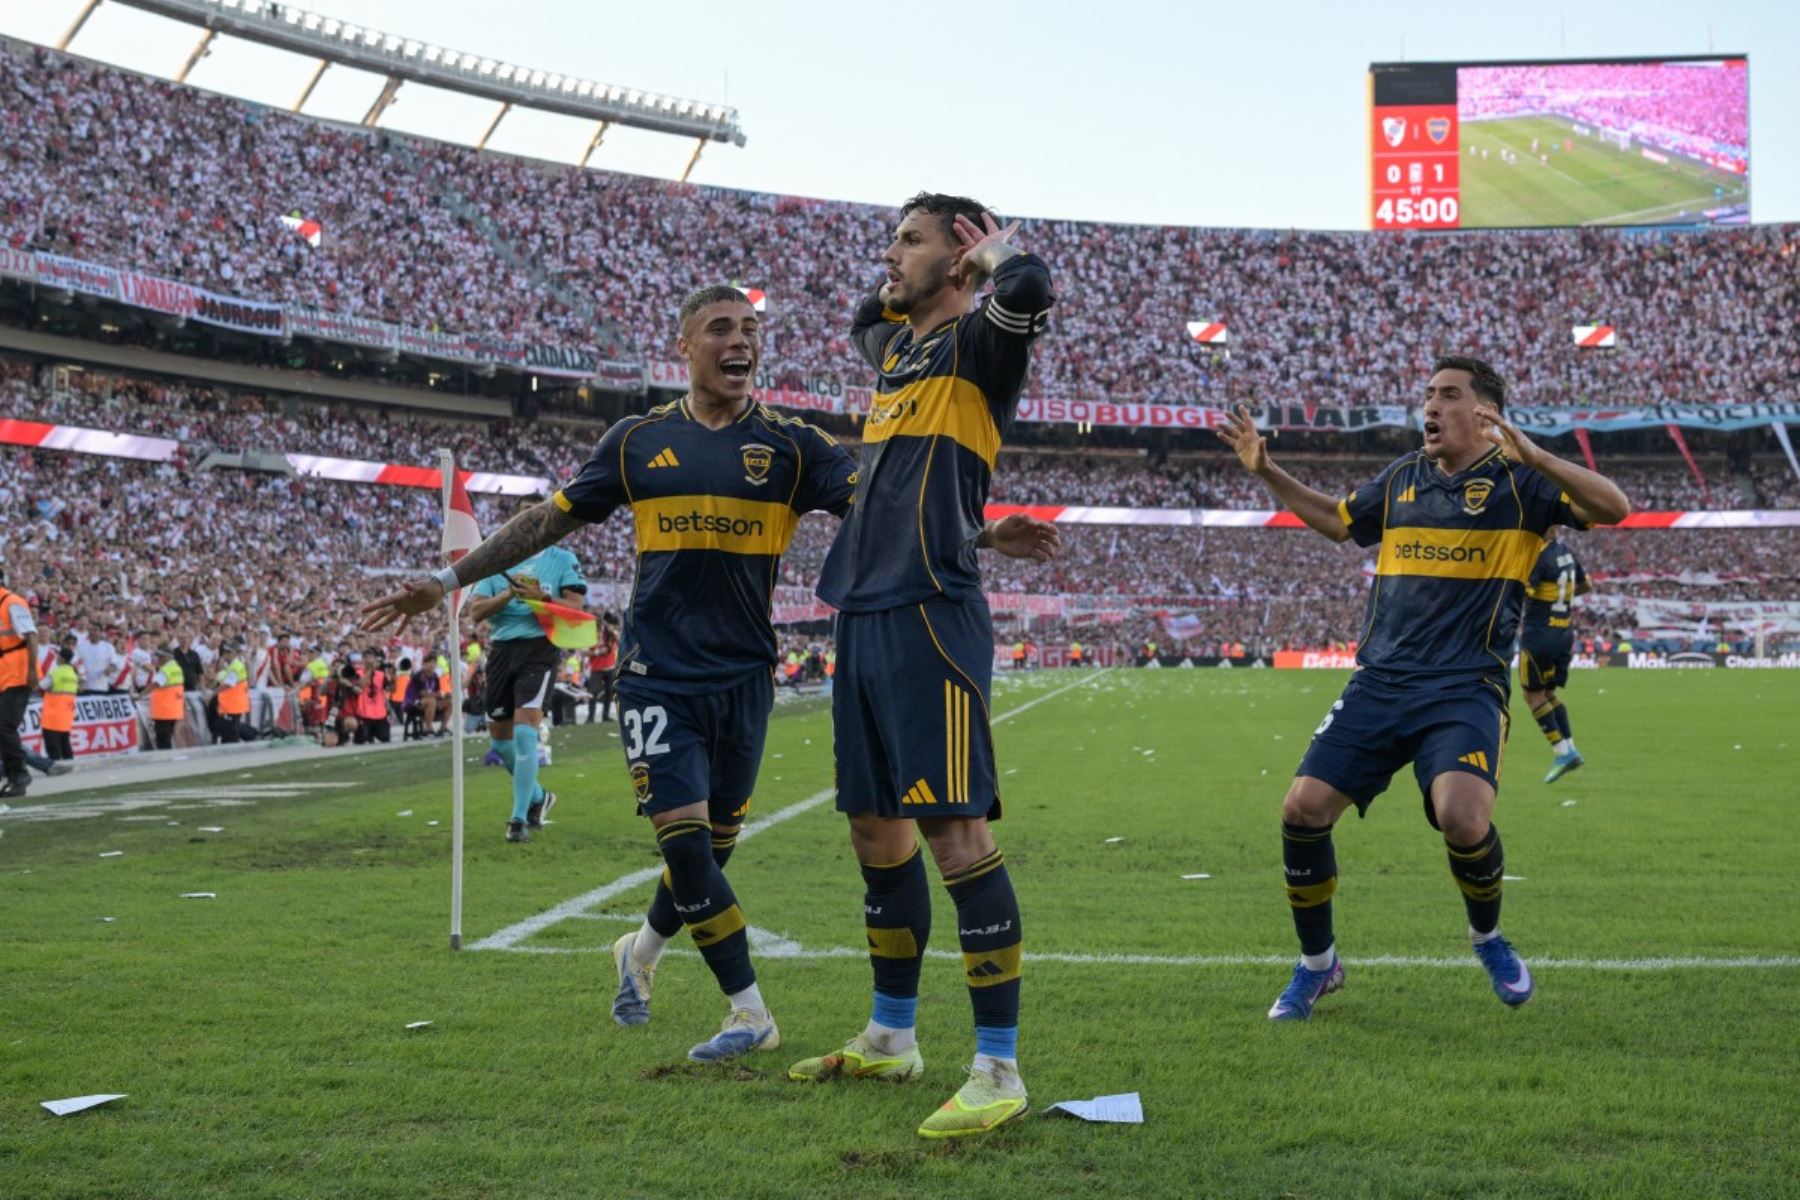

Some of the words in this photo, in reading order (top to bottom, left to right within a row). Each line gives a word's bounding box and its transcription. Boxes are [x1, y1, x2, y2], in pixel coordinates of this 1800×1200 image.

[1387, 165, 1401, 183] 0
[1434, 164, 1444, 182] 1
[1376, 197, 1458, 224] 45:00
[658, 510, 763, 536] betsson
[624, 706, 670, 760] 32
